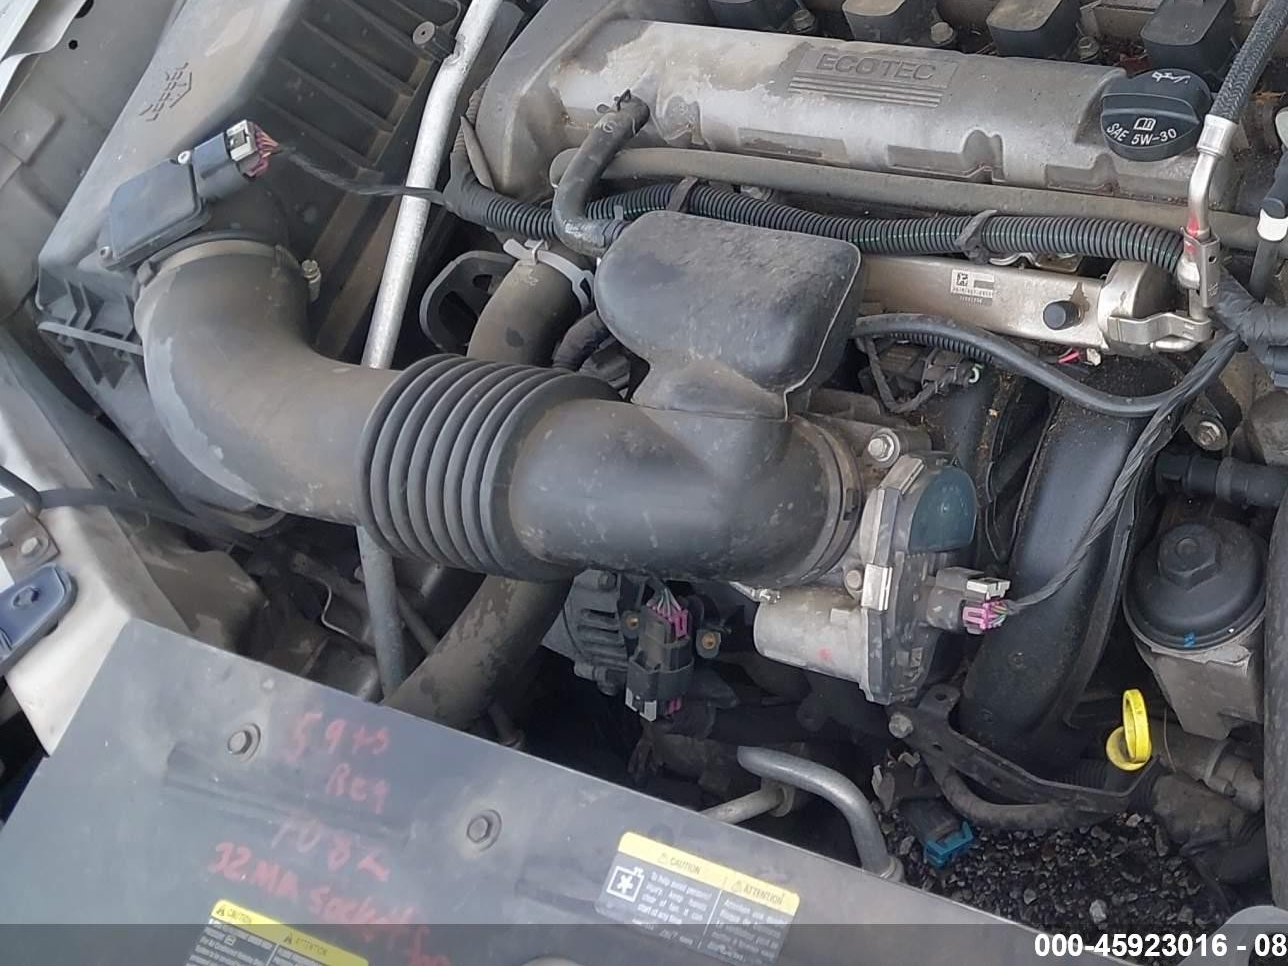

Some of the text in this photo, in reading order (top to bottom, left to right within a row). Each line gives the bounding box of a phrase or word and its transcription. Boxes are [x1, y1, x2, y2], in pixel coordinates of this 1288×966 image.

[815, 52, 937, 81] ECOTEC
[1106, 122, 1178, 146] SAE 5W-30
[669, 856, 701, 875] CAUTION
[743, 882, 785, 906] ATTENTION
